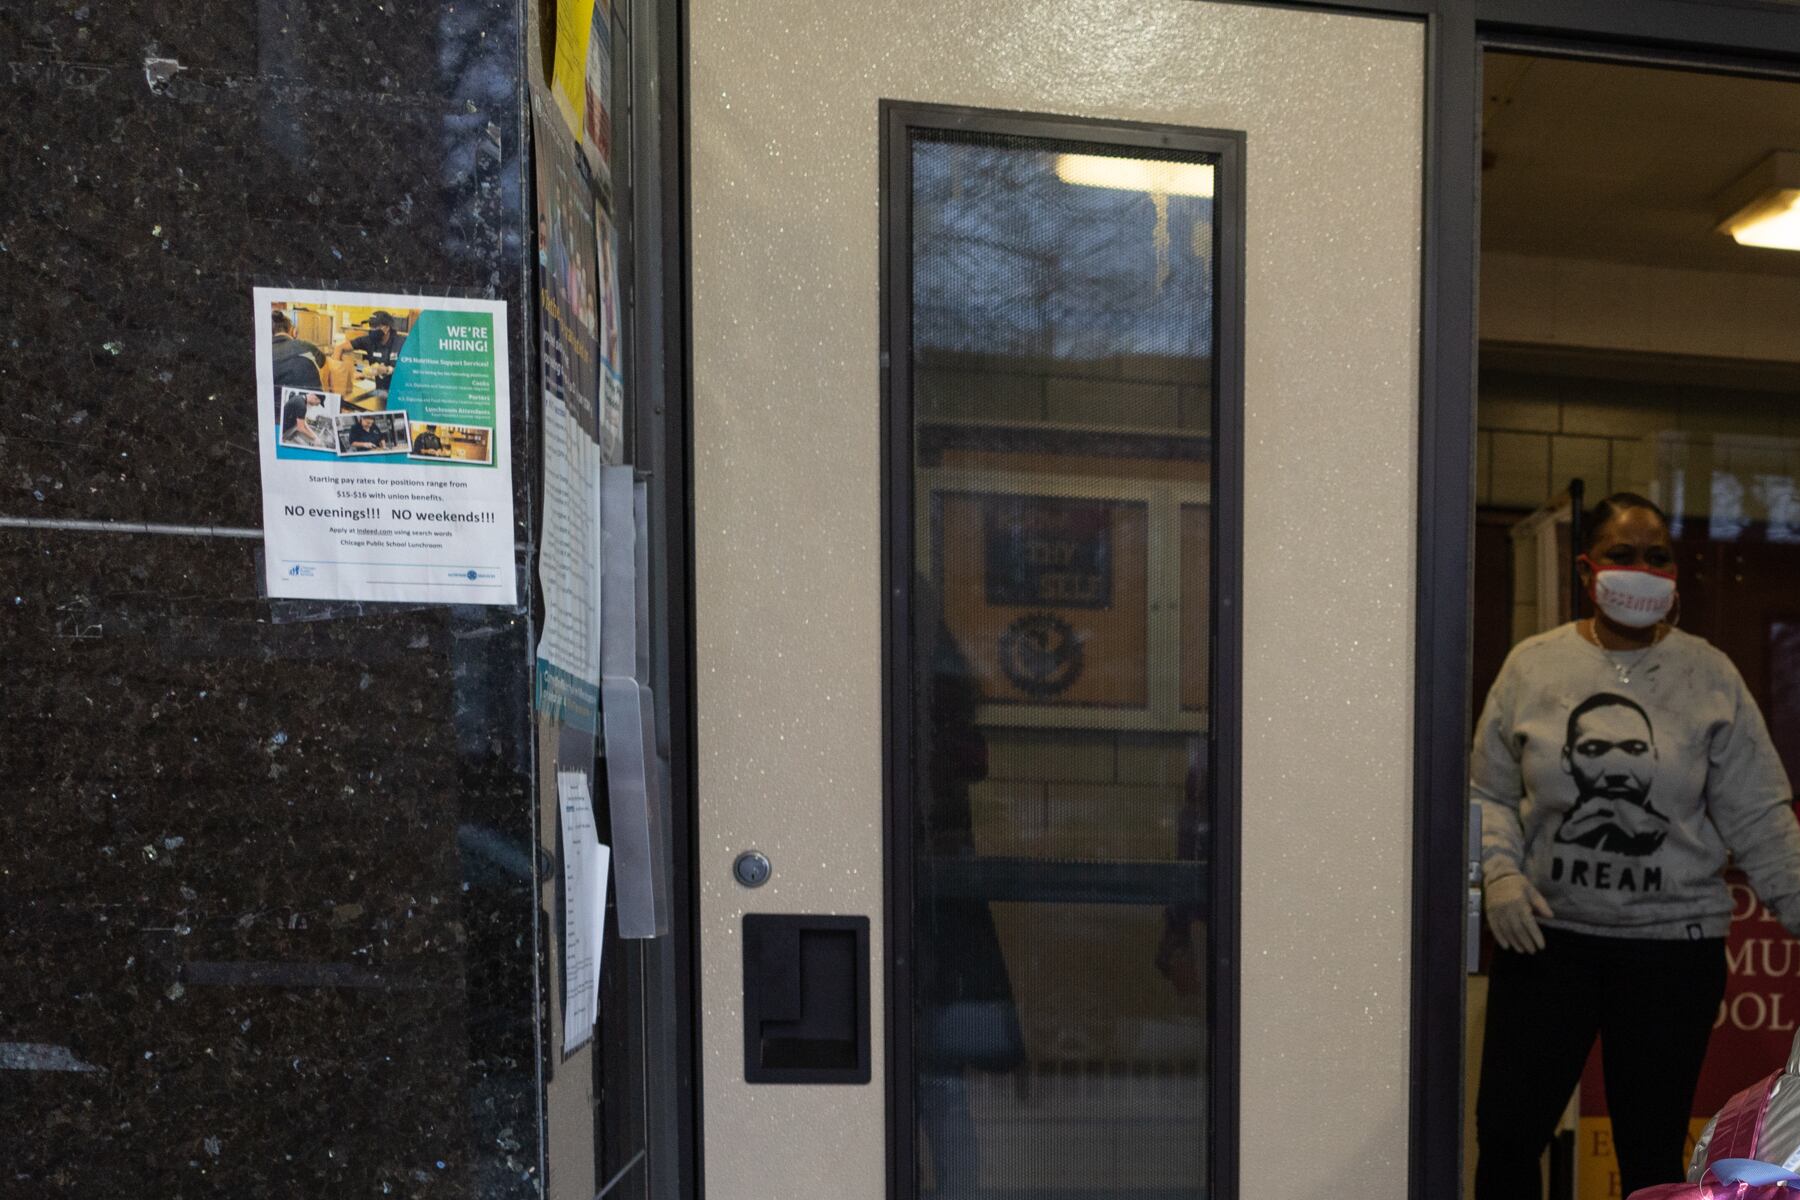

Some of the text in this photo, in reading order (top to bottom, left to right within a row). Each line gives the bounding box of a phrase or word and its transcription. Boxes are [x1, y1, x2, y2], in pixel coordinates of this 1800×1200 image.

[446, 326, 488, 339] WE'RE
[439, 338, 488, 352] HIRING!
[309, 475, 339, 485] Starting
[341, 478, 354, 486] pay
[378, 478, 388, 486] for
[390, 478, 425, 488] positions
[426, 481, 448, 489] range
[449, 480, 468, 488] from
[336, 490, 368, 499] $15-$16
[369, 491, 386, 500] with
[411, 493, 445, 502] benefits.
[284, 505, 380, 521] NO evenings!!!
[392, 509, 495, 524] NO weekends!!!
[329, 526, 348, 535] Apply
[434, 530, 453, 538] words
[340, 539, 443, 549] Chicago Public School Lunchroom
[1551, 858, 1662, 892] DREAM
